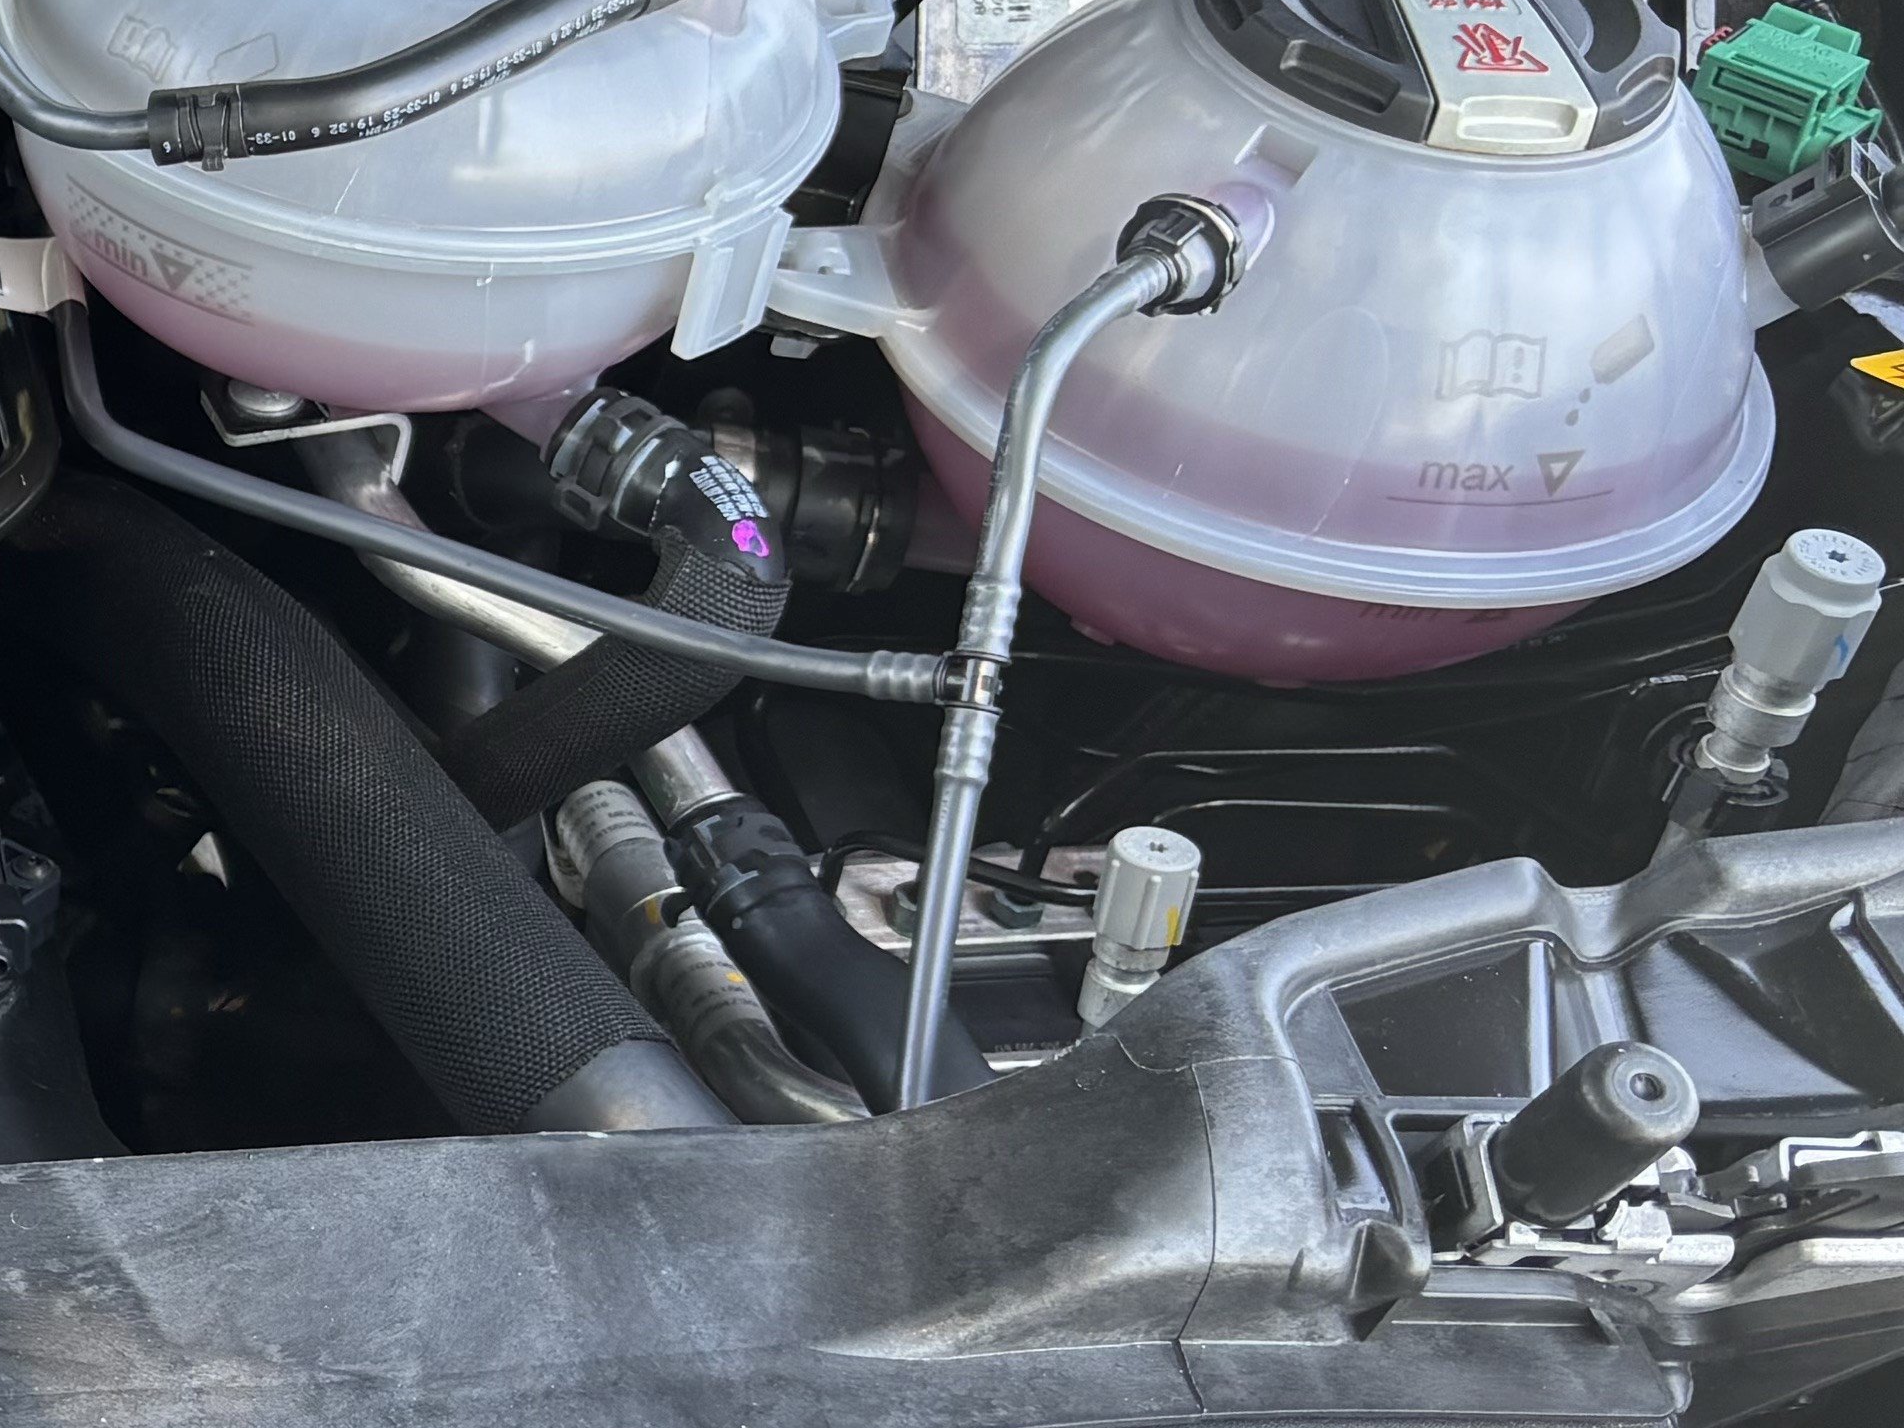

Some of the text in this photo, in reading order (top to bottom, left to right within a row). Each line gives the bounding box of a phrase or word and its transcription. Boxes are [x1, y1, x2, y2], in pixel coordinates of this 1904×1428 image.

[311, 127, 320, 138] 6
[94, 229, 149, 277] min
[1417, 458, 1515, 492] max
